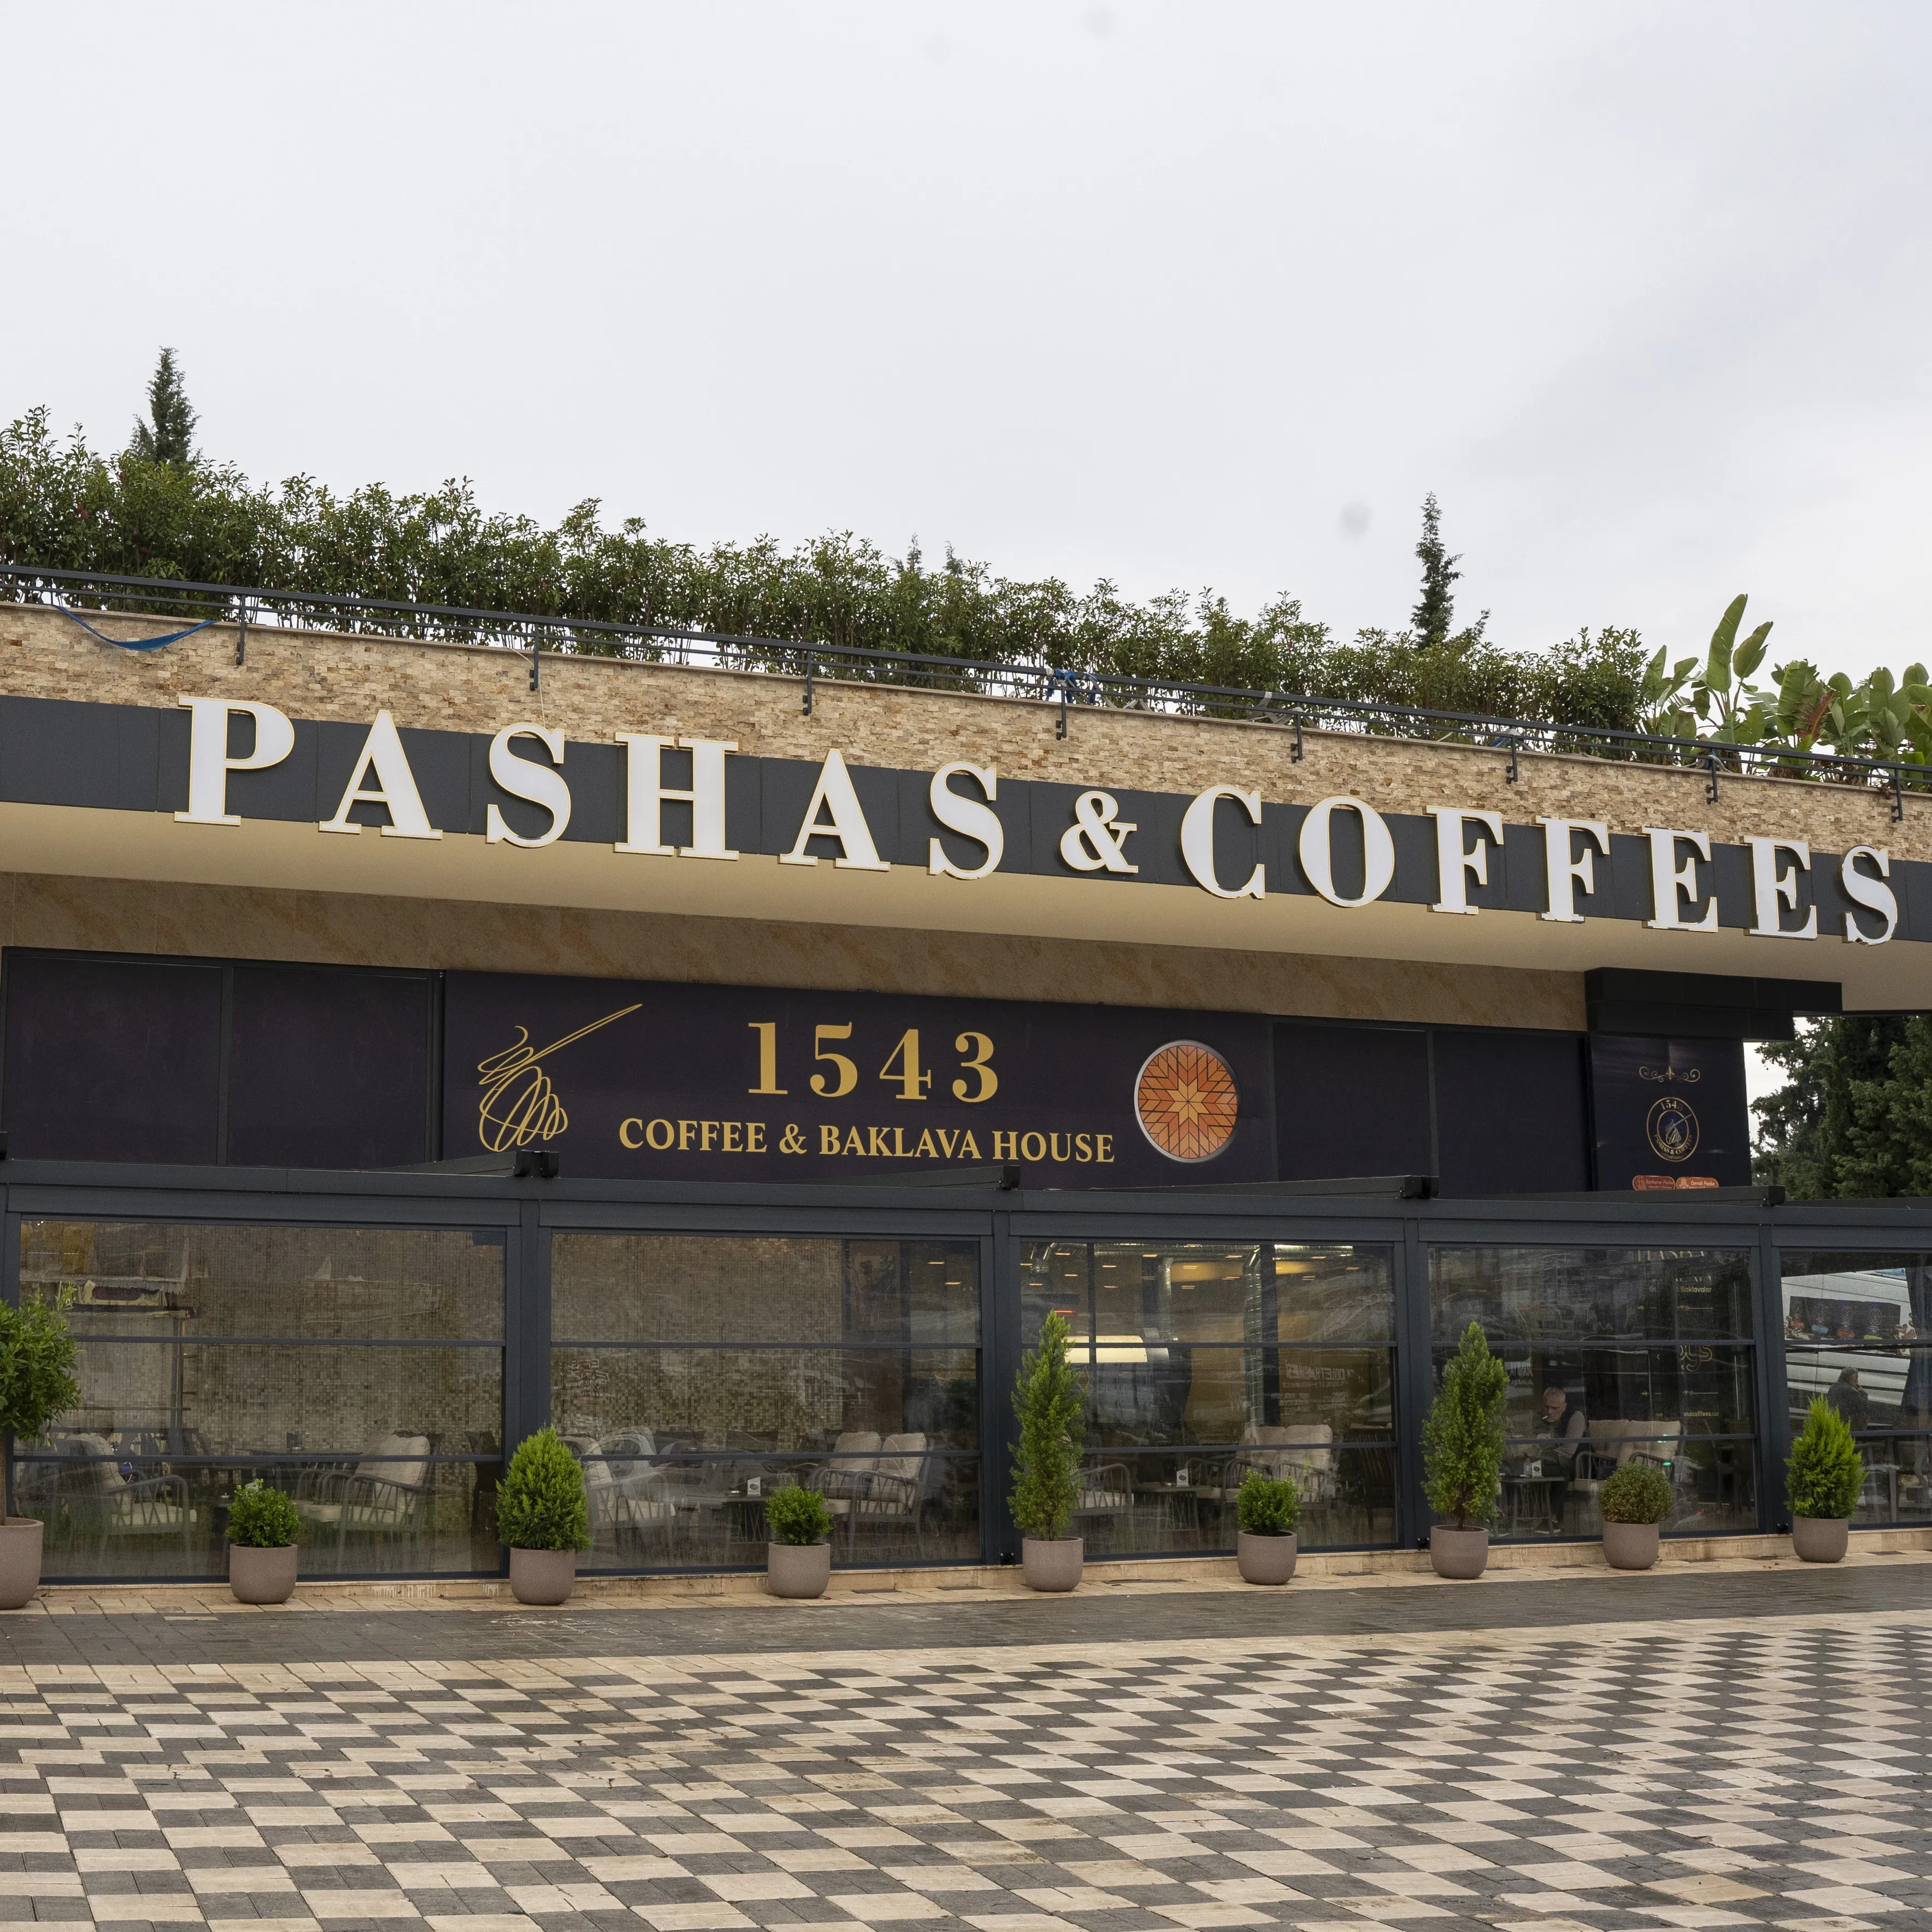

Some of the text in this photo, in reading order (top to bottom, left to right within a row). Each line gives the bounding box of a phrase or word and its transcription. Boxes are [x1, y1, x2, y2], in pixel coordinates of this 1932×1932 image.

[174, 695, 1898, 946] PASHAS & COFFEES
[747, 1021, 999, 1103] 1543
[619, 1117, 1115, 1163] COFFEE & BAKLAVA HOUSE
